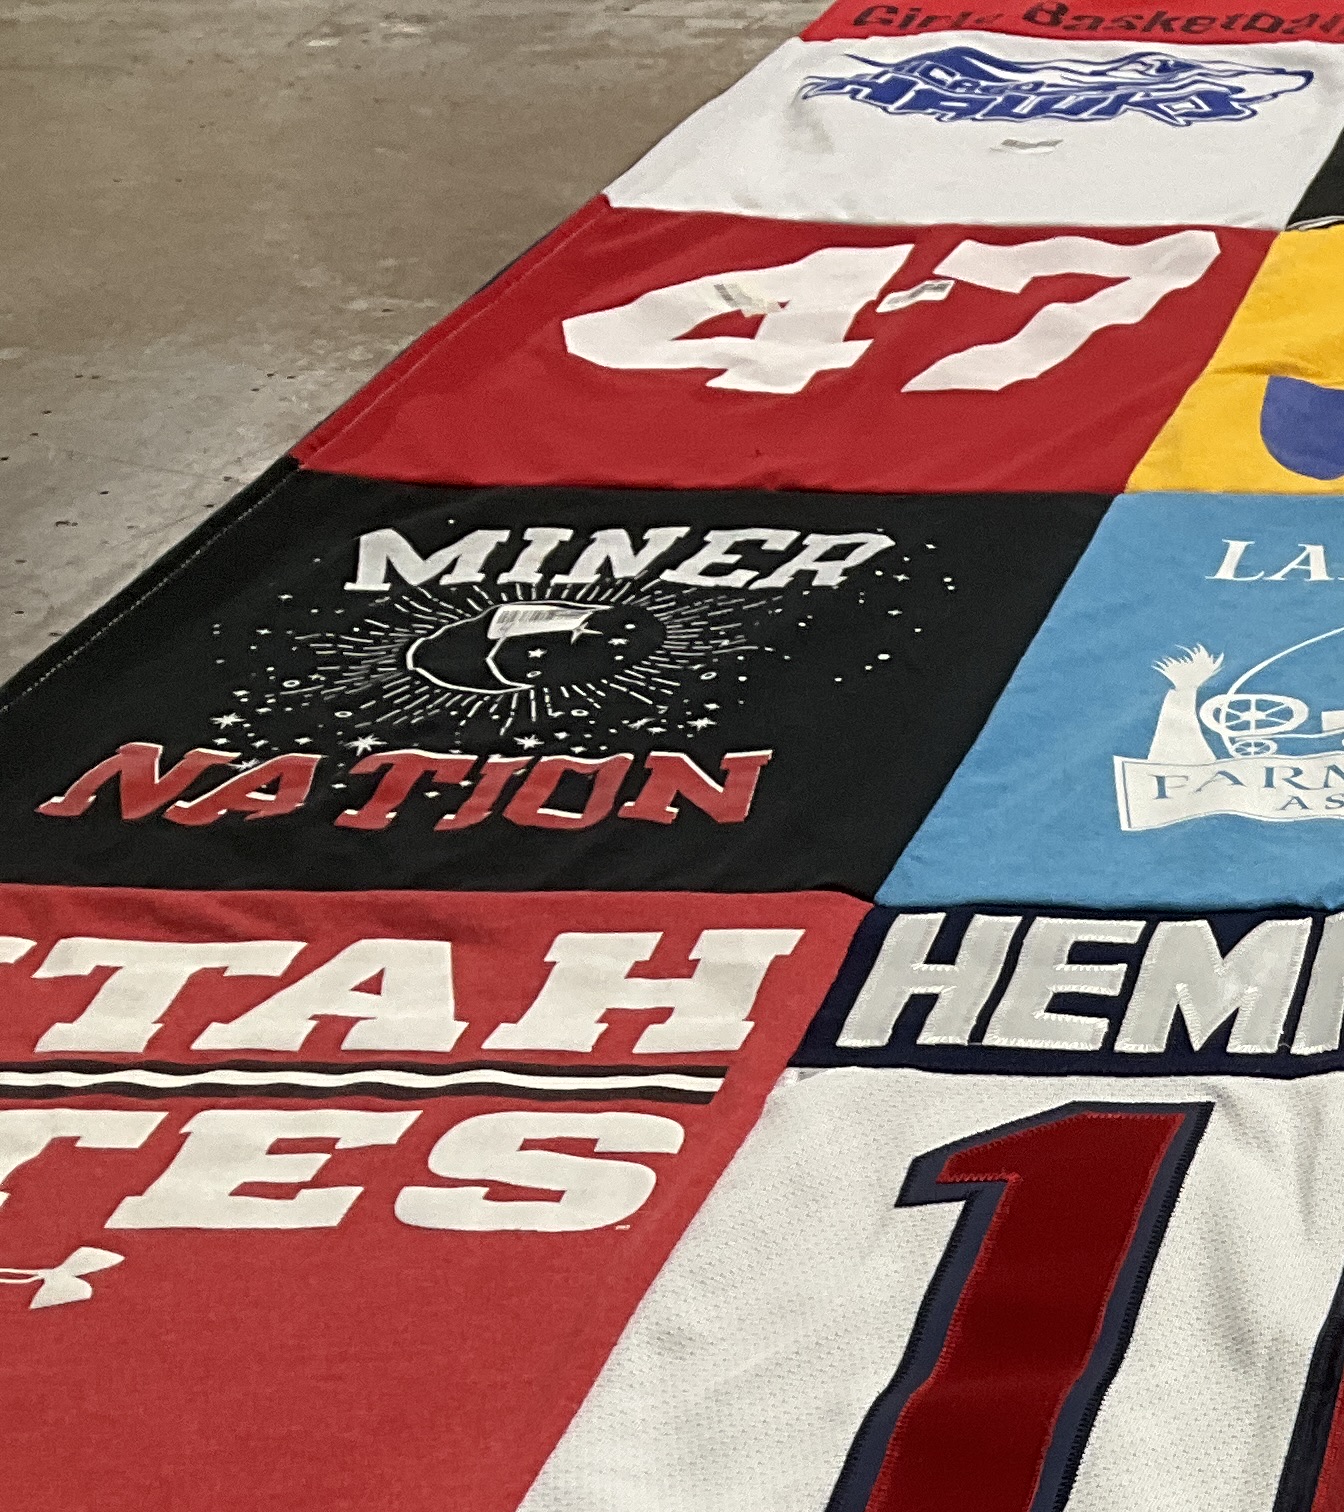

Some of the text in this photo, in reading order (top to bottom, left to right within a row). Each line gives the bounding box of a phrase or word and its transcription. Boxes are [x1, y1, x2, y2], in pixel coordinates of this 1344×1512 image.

[561, 230, 1221, 394] 47
[343, 526, 894, 592] MINER
[34, 741, 775, 832] NATION
[0, 928, 805, 1053] TAH
